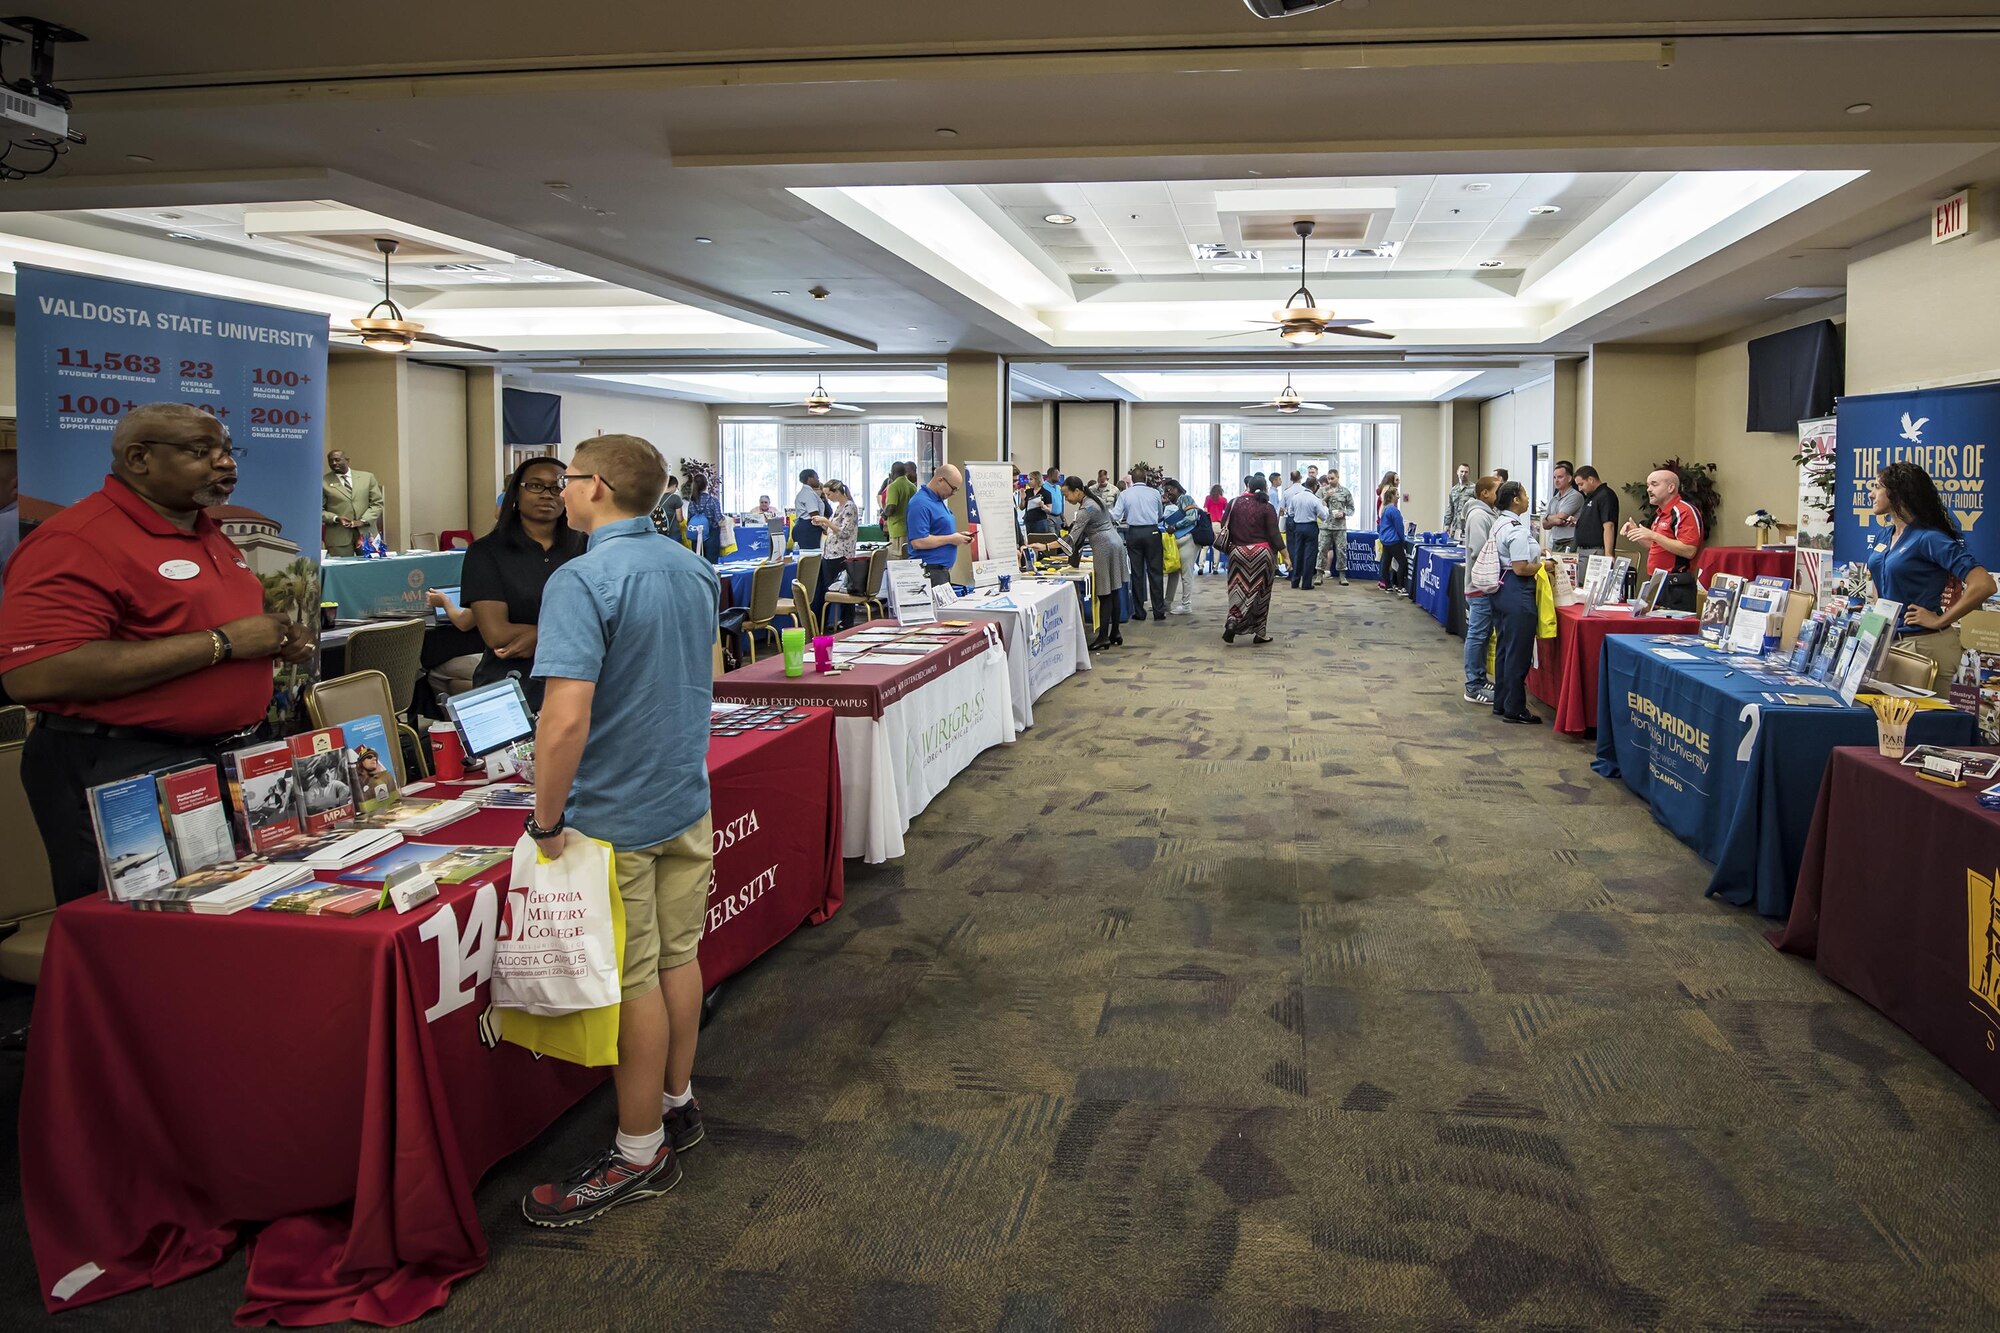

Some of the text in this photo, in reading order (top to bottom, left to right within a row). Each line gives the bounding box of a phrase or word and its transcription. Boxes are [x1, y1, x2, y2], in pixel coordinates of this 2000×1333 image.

[1936, 197, 1962, 238] EXIT
[38, 295, 314, 349] VALDOSTA STATE UNIVERSITY
[56, 347, 161, 375] 11,563
[179, 360, 214, 379] 23
[58, 369, 156, 383] STUDENT EXPERIENCES
[180, 380, 213, 389] AVERAGE
[252, 368, 312, 387] 100+
[180, 386, 204, 394] CLASS
[58, 394, 137, 416] 100+
[59, 416, 89, 424] STUDY
[250, 407, 312, 426] 200+
[1853, 447, 1882, 478] THE
[1962, 444, 1986, 478] OF
[1853, 479, 1985, 492] TOROW
[1853, 493, 1866, 507] ARE
[1347, 560, 1380, 575] University
[751, 697, 768, 706] AFB
[771, 698, 824, 707] EXTENDED
[826, 699, 868, 708] CAMPUS
[1949, 691, 1976, 700] ndustry's
[1736, 703, 1760, 762] 2
[1655, 770, 1683, 792] CAMPUS
[323, 809, 347, 823] MPA
[418, 882, 499, 1024] 14
